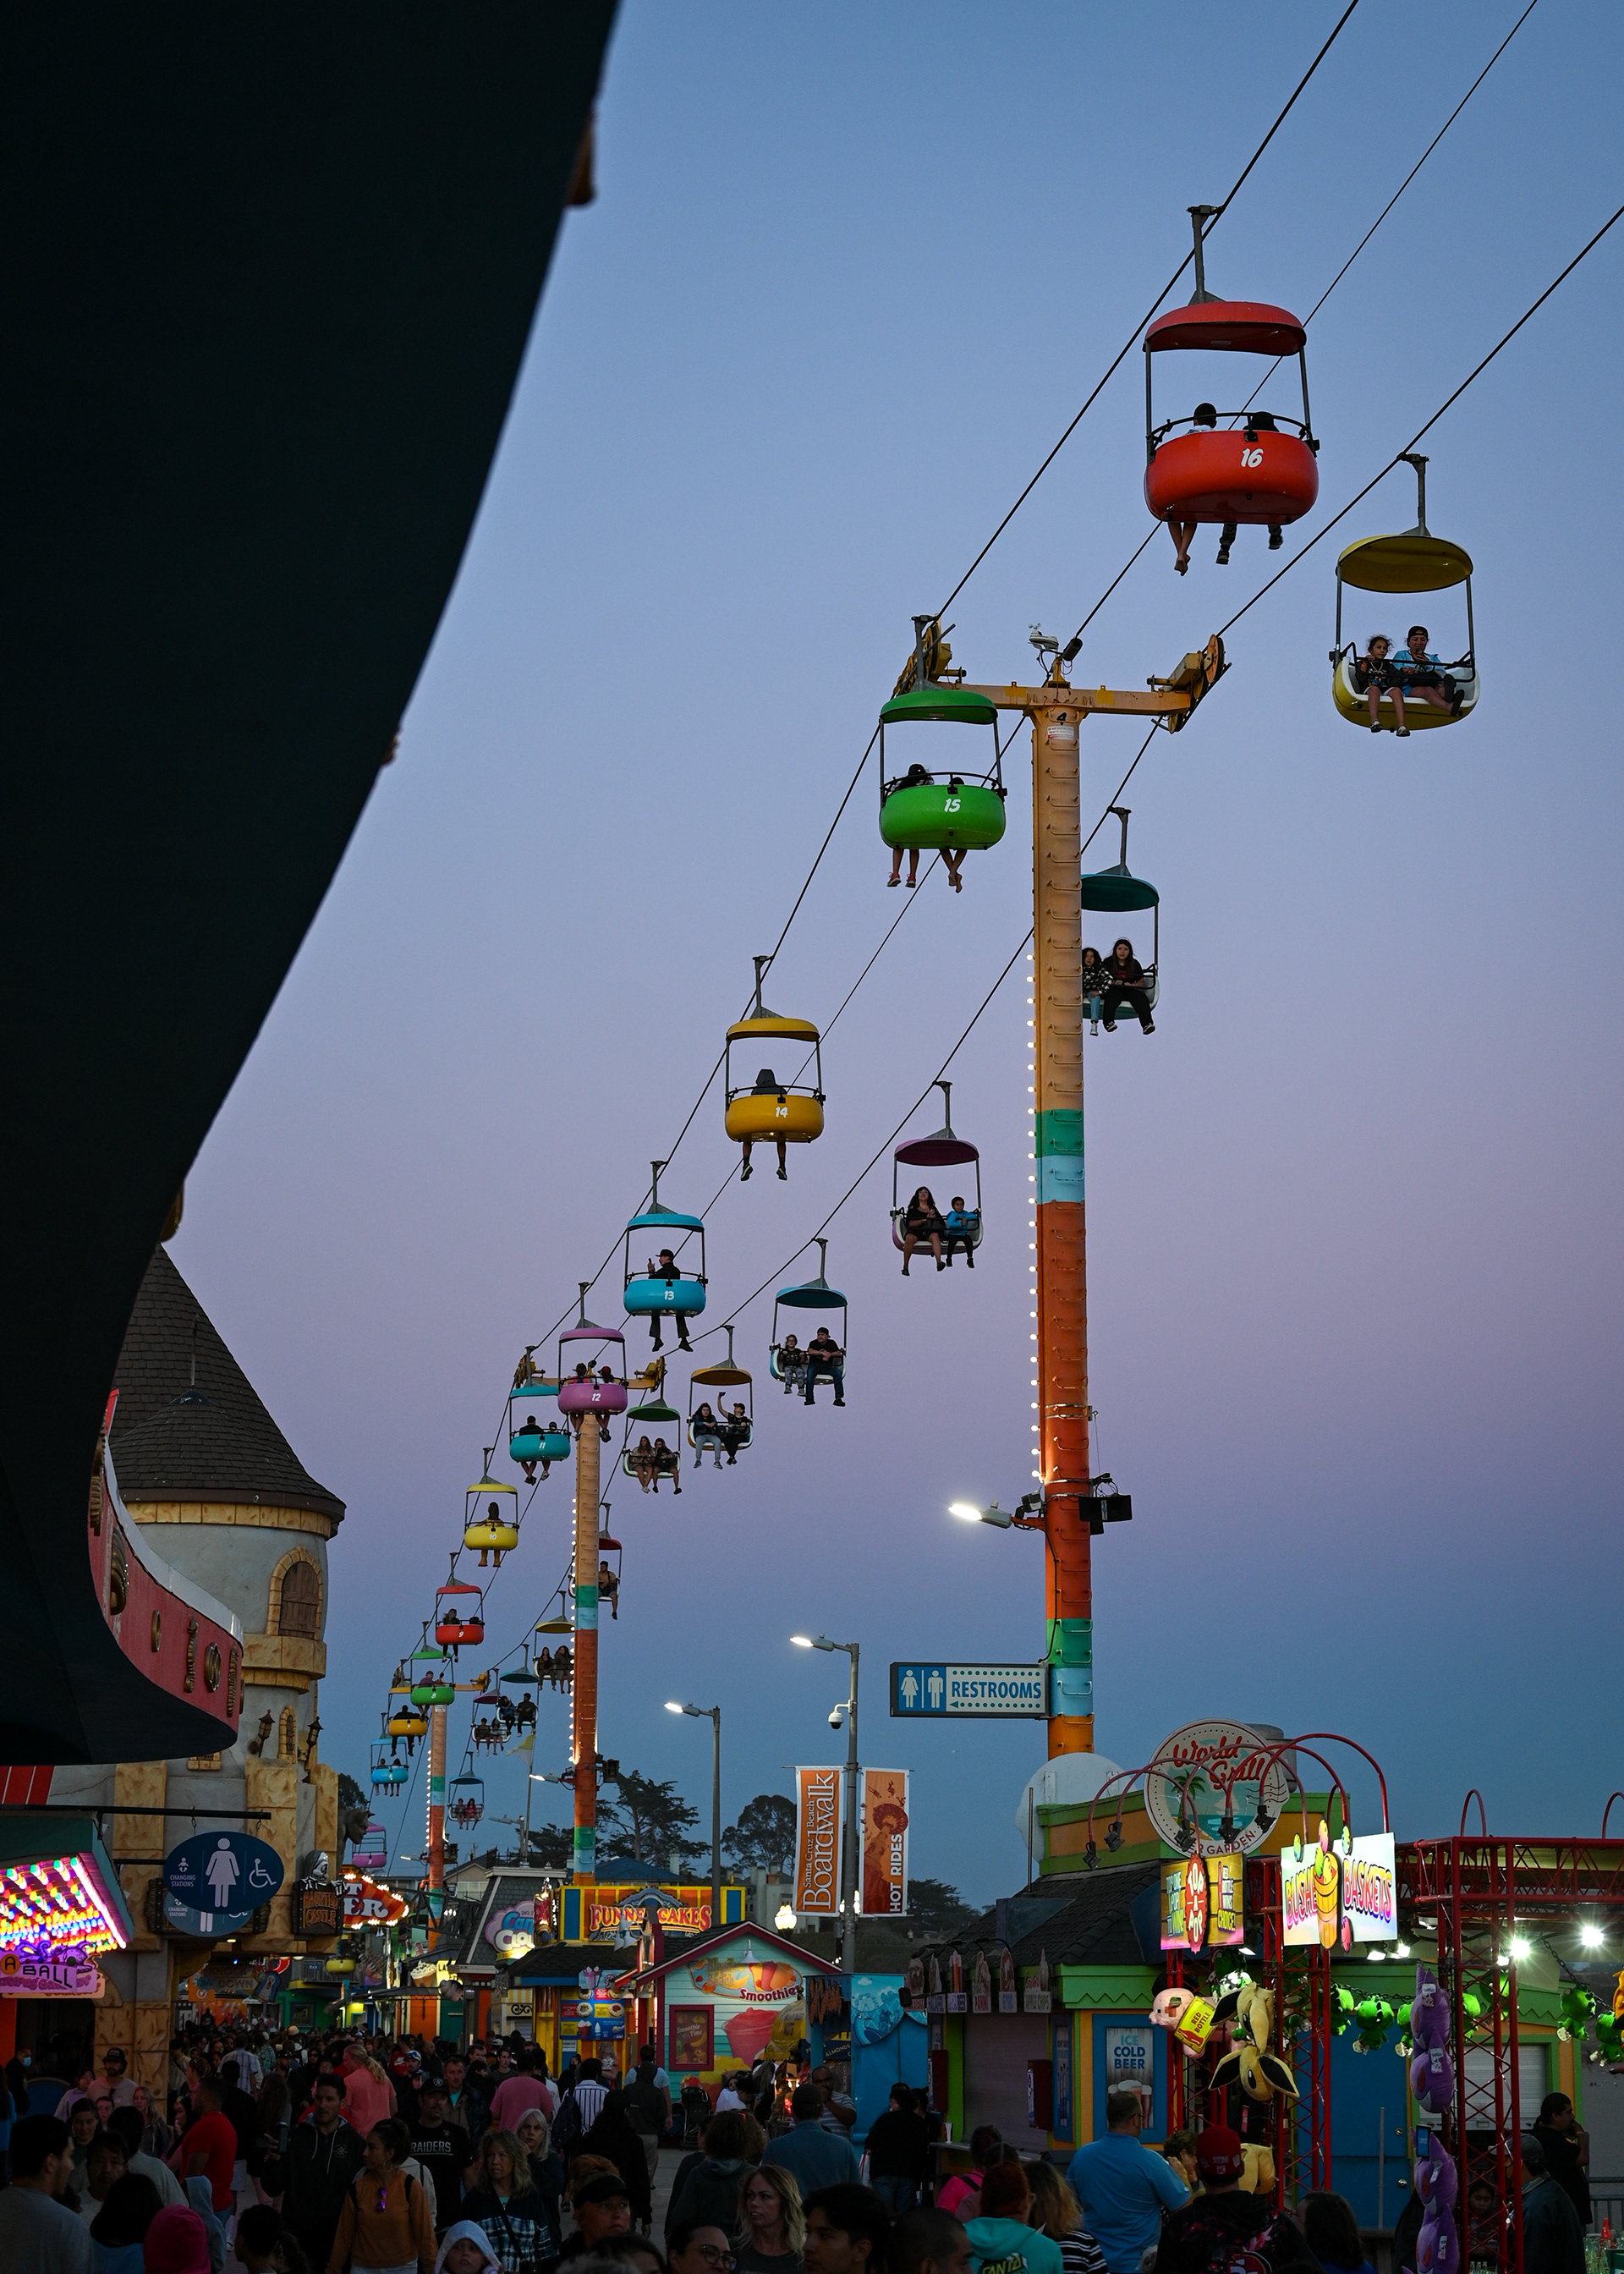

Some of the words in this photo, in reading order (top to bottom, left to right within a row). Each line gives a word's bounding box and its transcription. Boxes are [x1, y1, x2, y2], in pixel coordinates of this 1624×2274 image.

[1241, 448, 1264, 468] 16
[944, 798, 961, 813] 15
[776, 1106, 788, 1118] 14
[664, 1290, 675, 1300] 13
[952, 1681, 1041, 1699] RESTROOMS
[1173, 1736, 1242, 1767] World
[1210, 1757, 1265, 1789] Grill
[803, 1771, 834, 1910] Boardwalk
[804, 1838, 814, 1862] Cruz
[1207, 1831, 1255, 1855] GARDEN
[891, 1833, 903, 1876] RIDES
[804, 1862, 812, 1888] Santa
[304, 1892, 338, 1909] HAUNTED
[889, 1882, 902, 1913] HOT
[1285, 1863, 1317, 1930] BUSHE
[1342, 1858, 1391, 1924] BASKETS
[306, 1909, 336, 1929] CASTLE
[502, 1911, 534, 1934] Can
[590, 1903, 647, 1931] FUNNE
[656, 1904, 712, 1932] CAKES
[4, 1956, 16, 1970] A
[209, 1967, 247, 1976] KNOCK
[23, 1965, 73, 1989] BALL
[217, 1979, 254, 1989] DOWN
[1191, 2012, 1202, 2025] RED
[1194, 2011, 1211, 2034] BOTTLE
[677, 2023, 700, 2034] Smoothie
[1121, 2035, 1138, 2046] ICE
[826, 2044, 851, 2057] ALMONDS
[1114, 2046, 1145, 2057] COLD
[1114, 2058, 1145, 2069] BEER
[411, 2140, 452, 2153] RAIDERS
